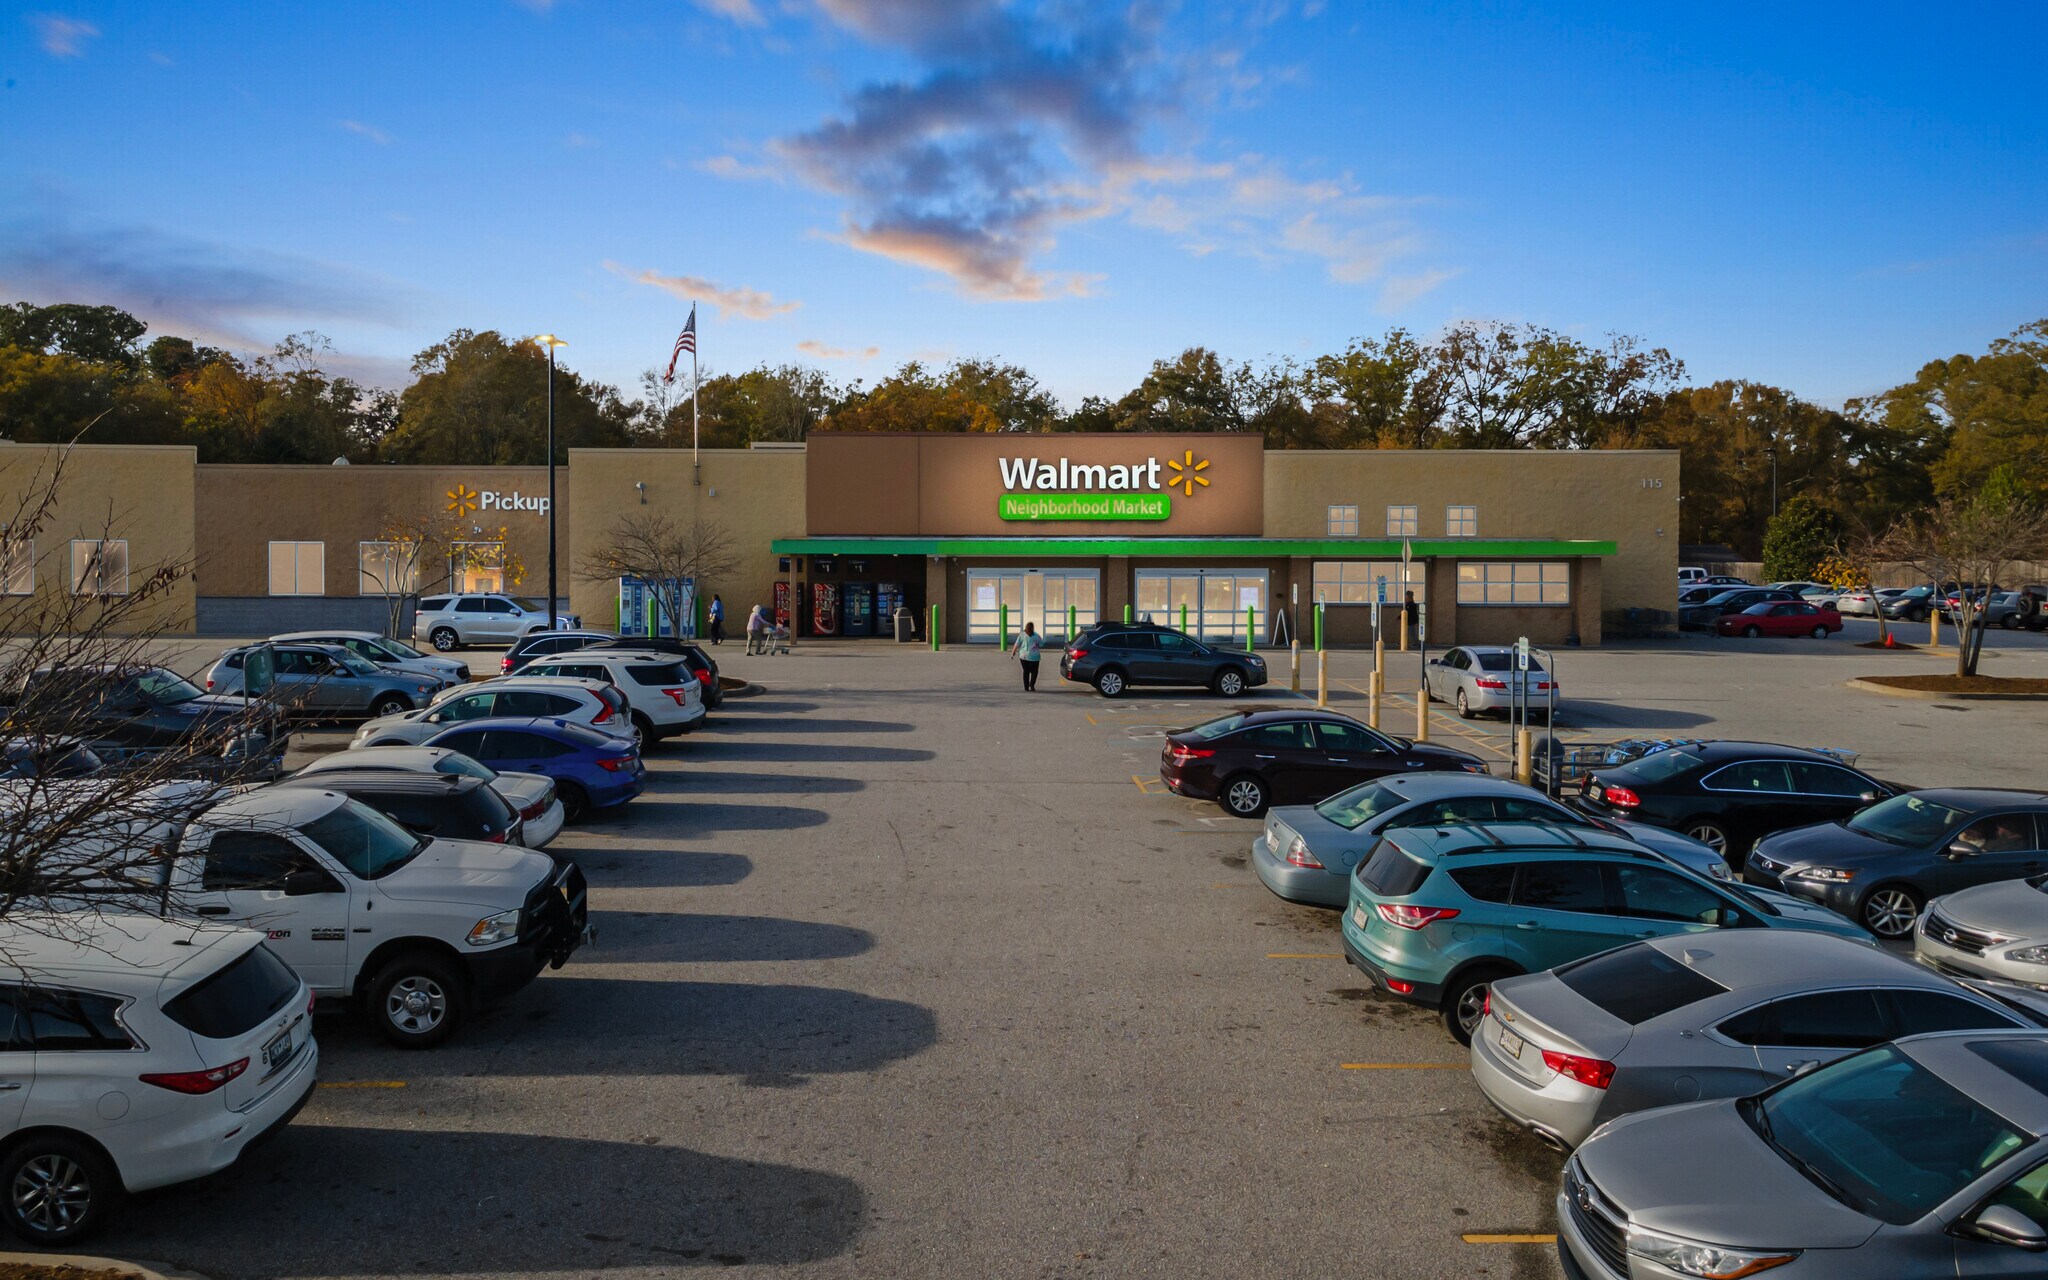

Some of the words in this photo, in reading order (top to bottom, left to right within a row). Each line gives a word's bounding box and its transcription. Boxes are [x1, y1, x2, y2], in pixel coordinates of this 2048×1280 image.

[998, 457, 1161, 490] Walmart
[1641, 478, 1663, 489] 115
[481, 491, 550, 516] Pickup
[1007, 499, 1109, 519] Neighborhood
[1113, 500, 1163, 515] Market
